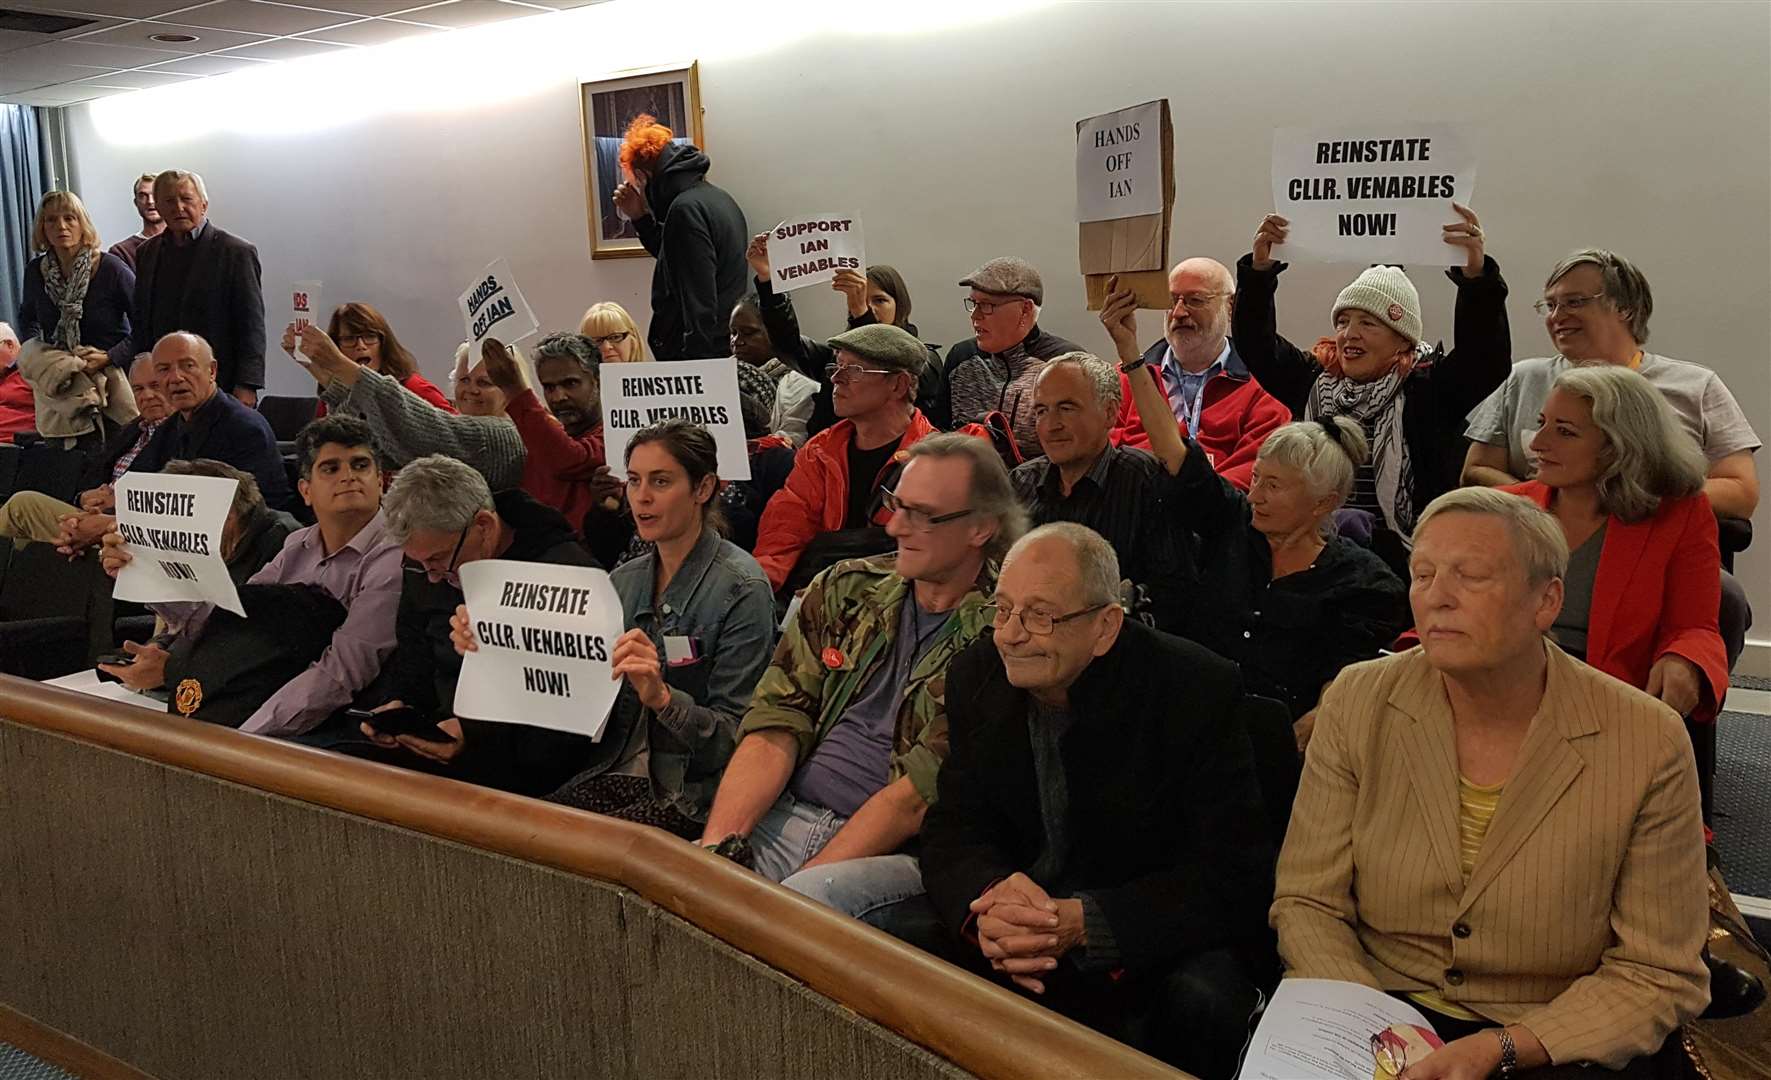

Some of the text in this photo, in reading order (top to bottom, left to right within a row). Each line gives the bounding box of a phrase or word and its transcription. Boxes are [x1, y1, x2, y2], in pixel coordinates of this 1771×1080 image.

[1095, 122, 1140, 148] HANDS
[1106, 151, 1132, 172] OFF
[1316, 138, 1431, 164] REINSTATE
[1109, 178, 1132, 198] IAN
[1288, 175, 1455, 201] CLLR. VENABLES
[776, 219, 852, 240] SUPPORT
[1338, 213, 1397, 236] NOW!
[800, 239, 829, 254] IAN
[777, 257, 860, 280] VENABLES
[467, 275, 498, 313] HANDS
[473, 296, 513, 337] OFF IAN
[622, 375, 704, 397] REINSTATE
[611, 406, 729, 428] CLLR. VENABLES
[127, 489, 196, 517] REINSTATE
[120, 523, 210, 556] CLLR. VENABLES
[158, 560, 199, 582] NOW!
[500, 581, 590, 616] REINSTATE
[477, 621, 608, 662] CLLR. VENABLES
[523, 666, 571, 698] NOW!
